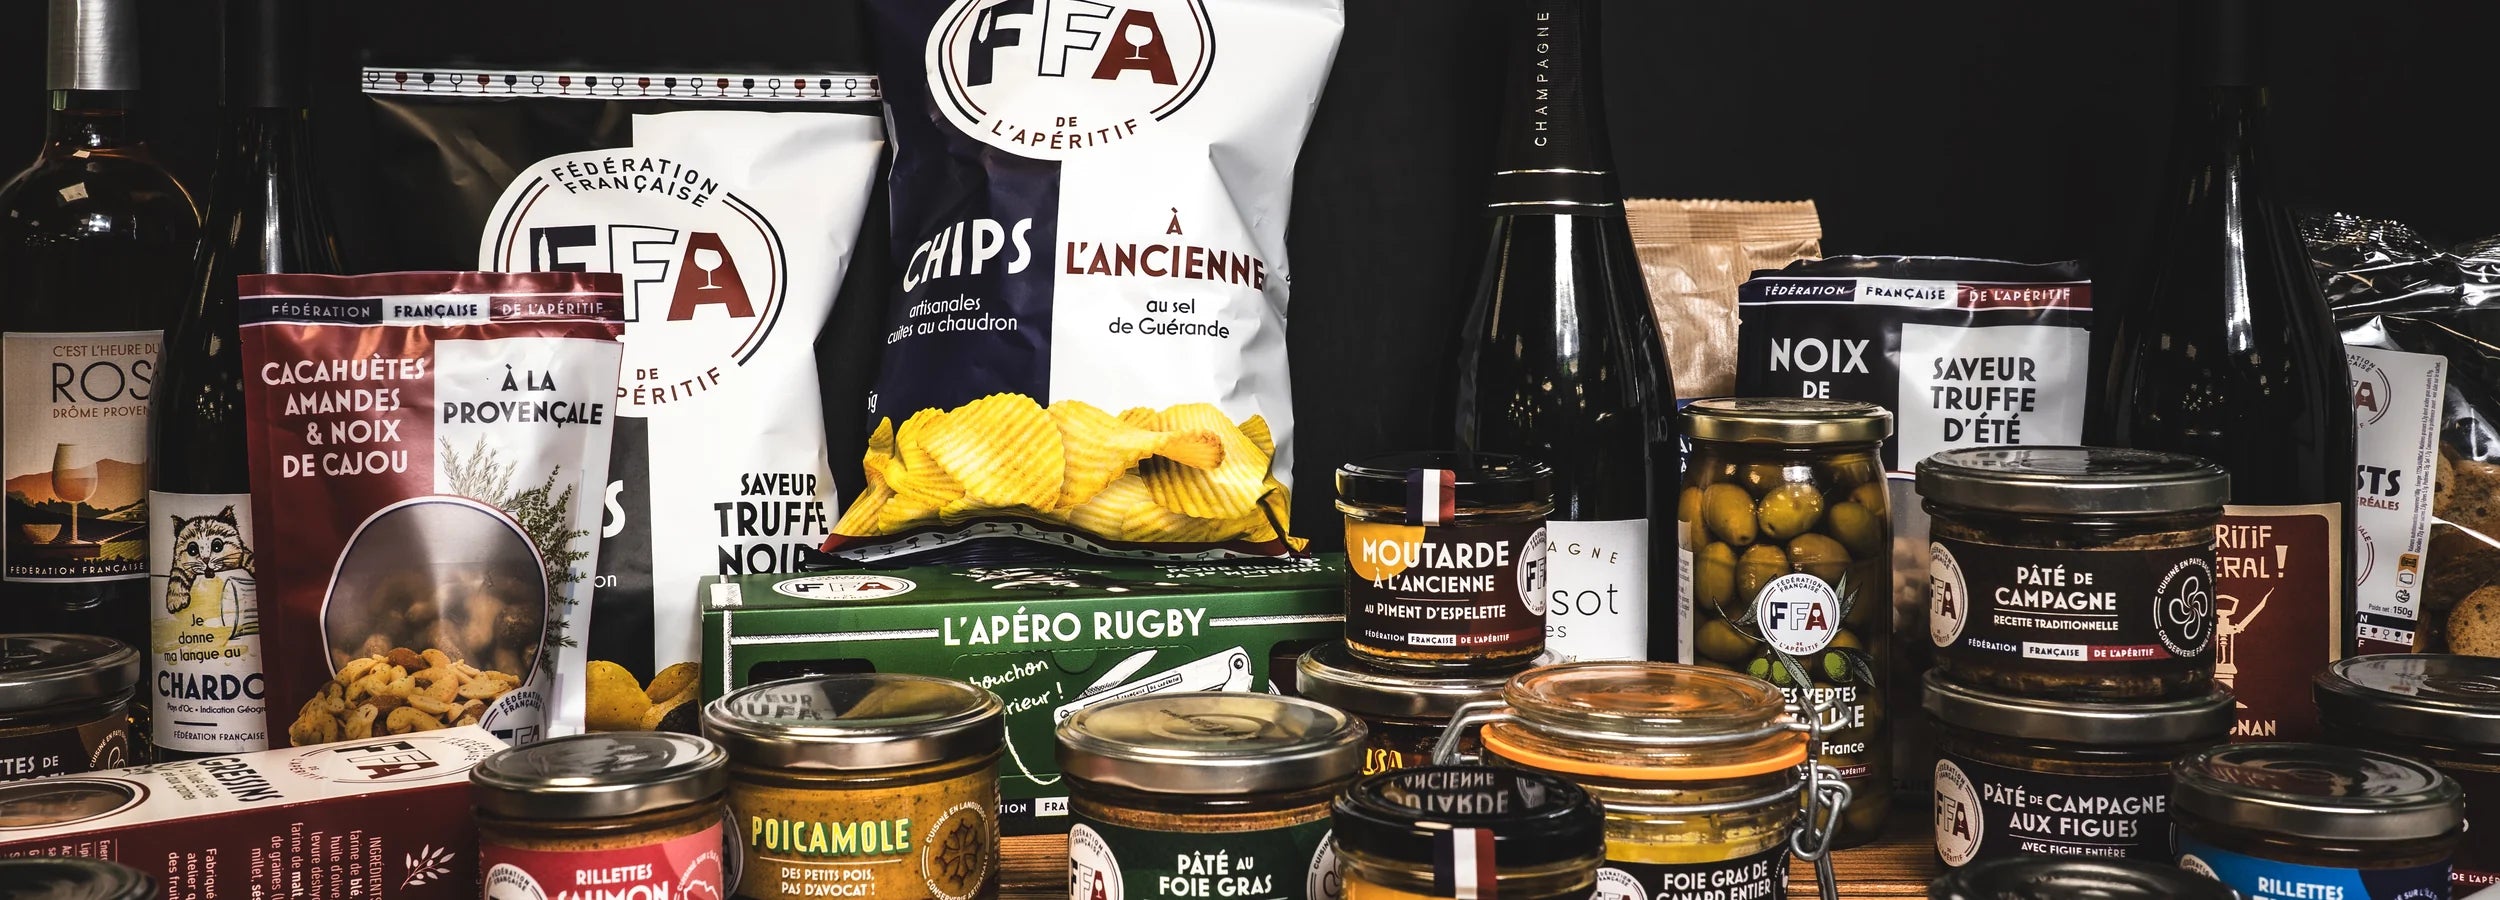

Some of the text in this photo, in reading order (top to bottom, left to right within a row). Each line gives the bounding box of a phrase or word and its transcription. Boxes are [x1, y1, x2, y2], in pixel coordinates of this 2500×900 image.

[967, 0, 1179, 87] FFA
[1534, 12, 1550, 147] CHAMPAGNE
[991, 118, 1139, 150] L'APÉRITIF
[1056, 116, 1078, 127] DE
[550, 157, 719, 196] FÉDÉRATION
[563, 174, 709, 208] FRANÇAISE
[1166, 207, 1183, 235] À
[902, 217, 1033, 293] CHIPS
[1065, 241, 1265, 291] L'ANCIENNE
[529, 224, 756, 322] FFA
[909, 293, 981, 318] artisanales
[1765, 283, 2072, 302] FÉDÉRATION FRANÇAISE DE L'APÉRITIF
[271, 300, 605, 321] FÉDÉRATION FRANÇAISE DE L'APÉRITIF
[1146, 299, 1195, 314] au sel
[917, 322, 935, 335] au
[938, 312, 1018, 333] chaudron
[1109, 315, 1230, 340] de Guérande
[53, 345, 88, 357] C'EST
[92, 344, 142, 357] L'HEURE
[1769, 337, 1870, 375] NOIX
[52, 360, 160, 403] ROS
[261, 352, 426, 387] CACAHUÈTES
[500, 363, 557, 392] À LA
[636, 368, 659, 381] DE
[1932, 356, 2037, 382] SAVEUR
[284, 388, 401, 417] AMANDES
[1802, 380, 1830, 400] DE
[1930, 385, 2036, 412] TRUFFE
[53, 405, 98, 418] DRÔME
[443, 400, 604, 428] PROVENÇALE
[306, 419, 402, 446] & NOIX
[1943, 411, 2021, 444] D'ÉTÉ
[282, 449, 408, 478] DE CAJOU
[740, 472, 817, 497] SAVEUR
[714, 501, 829, 537] TRUFFE
[1362, 537, 1509, 570] MOUTARDE
[10, 562, 144, 577] FÉDÉRATION FRANÇAISE
[1373, 568, 1495, 594] À L'ANCIENNE
[2016, 563, 2093, 587] PÂTÉ DE
[2157, 563, 2181, 595] CUISINÉ
[2179, 559, 2189, 571] EN
[1776, 577, 1822, 589] FÉDÉRATION
[1779, 582, 1820, 594] FRANÇAISE
[1364, 601, 1507, 620] AU PIMENT D'ESPELETTE
[1994, 586, 2117, 612] CAMPAGNE
[2392, 605, 2413, 618] 150g
[191, 613, 205, 627] Je
[943, 605, 1207, 646] L'APÉRO RUGBY
[1770, 602, 1828, 631] FFA
[1994, 614, 2119, 632] RECETTE TRADITIONNELLE
[178, 631, 215, 645] donne
[1365, 629, 1510, 645] FÉDÉRATION FRANÇAISE DE L'APÉRITIF
[1779, 642, 1819, 652] L'APÉRITIF
[1968, 636, 2155, 659] FÉDÉRATION FRANÇAISE DE L'APÉRITIF
[163, 647, 241, 664] ma langue au
[200, 704, 235, 715] Indication
[173, 730, 265, 742] FÉDÉRATION FRANÇAISE
[1821, 741, 1865, 755] France
[43, 755, 59, 769] DE
[198, 756, 285, 802] GRESSINS
[1983, 782, 2166, 815] PÂTÉ DE CAMPAGNE
[751, 815, 913, 856] POICAMOLE
[926, 804, 959, 844] CUISINÉ EN
[2009, 812, 2138, 839] AUX FIGUES
[292, 822, 304, 853] farine
[310, 831, 324, 864] levure
[330, 835, 343, 862] huile
[350, 829, 363, 860] farine
[2021, 841, 2047, 854] AVEC
[2085, 846, 2126, 858] ENTIÈRE
[168, 852, 180, 874] des
[187, 852, 199, 890] atelier
[204, 848, 218, 899] Fabriqué
[268, 835, 284, 891] de graines
[292, 856, 304, 869] de
[350, 863, 363, 876] de
[575, 863, 653, 885] RILLETTES
[781, 866, 875, 883] DES PETITS POIS,
[1177, 849, 1254, 875] PÂTÉ AU
[1663, 860, 1768, 890] FOIE GRAS DE
[781, 881, 875, 896] PAS D'AVOCAT !
[1159, 873, 1273, 897] FOIE GRAS
[1730, 878, 1772, 900] ENTIER
[2257, 876, 2344, 900] RILLETTES
[2451, 872, 2465, 882] DE
